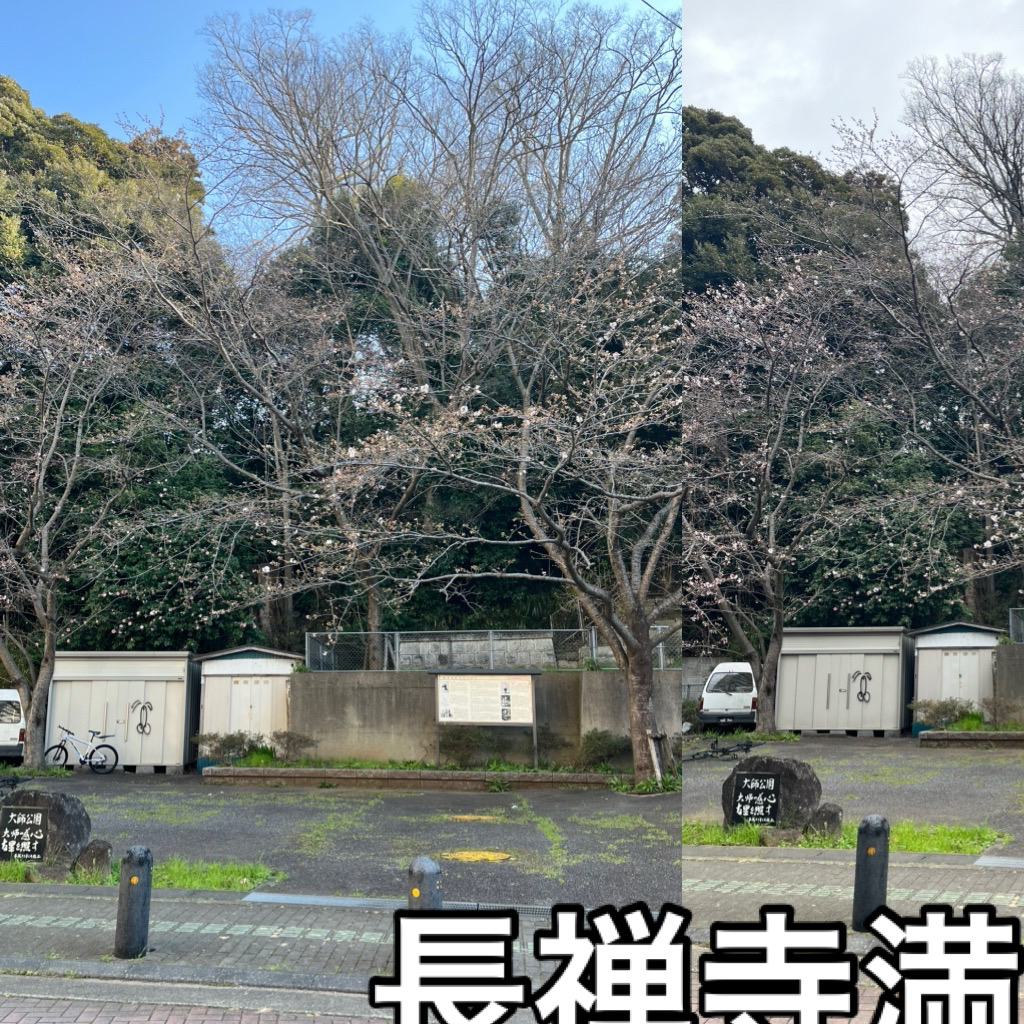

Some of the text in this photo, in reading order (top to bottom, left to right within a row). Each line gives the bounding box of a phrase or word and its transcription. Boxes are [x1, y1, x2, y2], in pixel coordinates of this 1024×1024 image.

[742, 778, 775, 790] 大師公園
[8, 813, 42, 826] 大師公園
